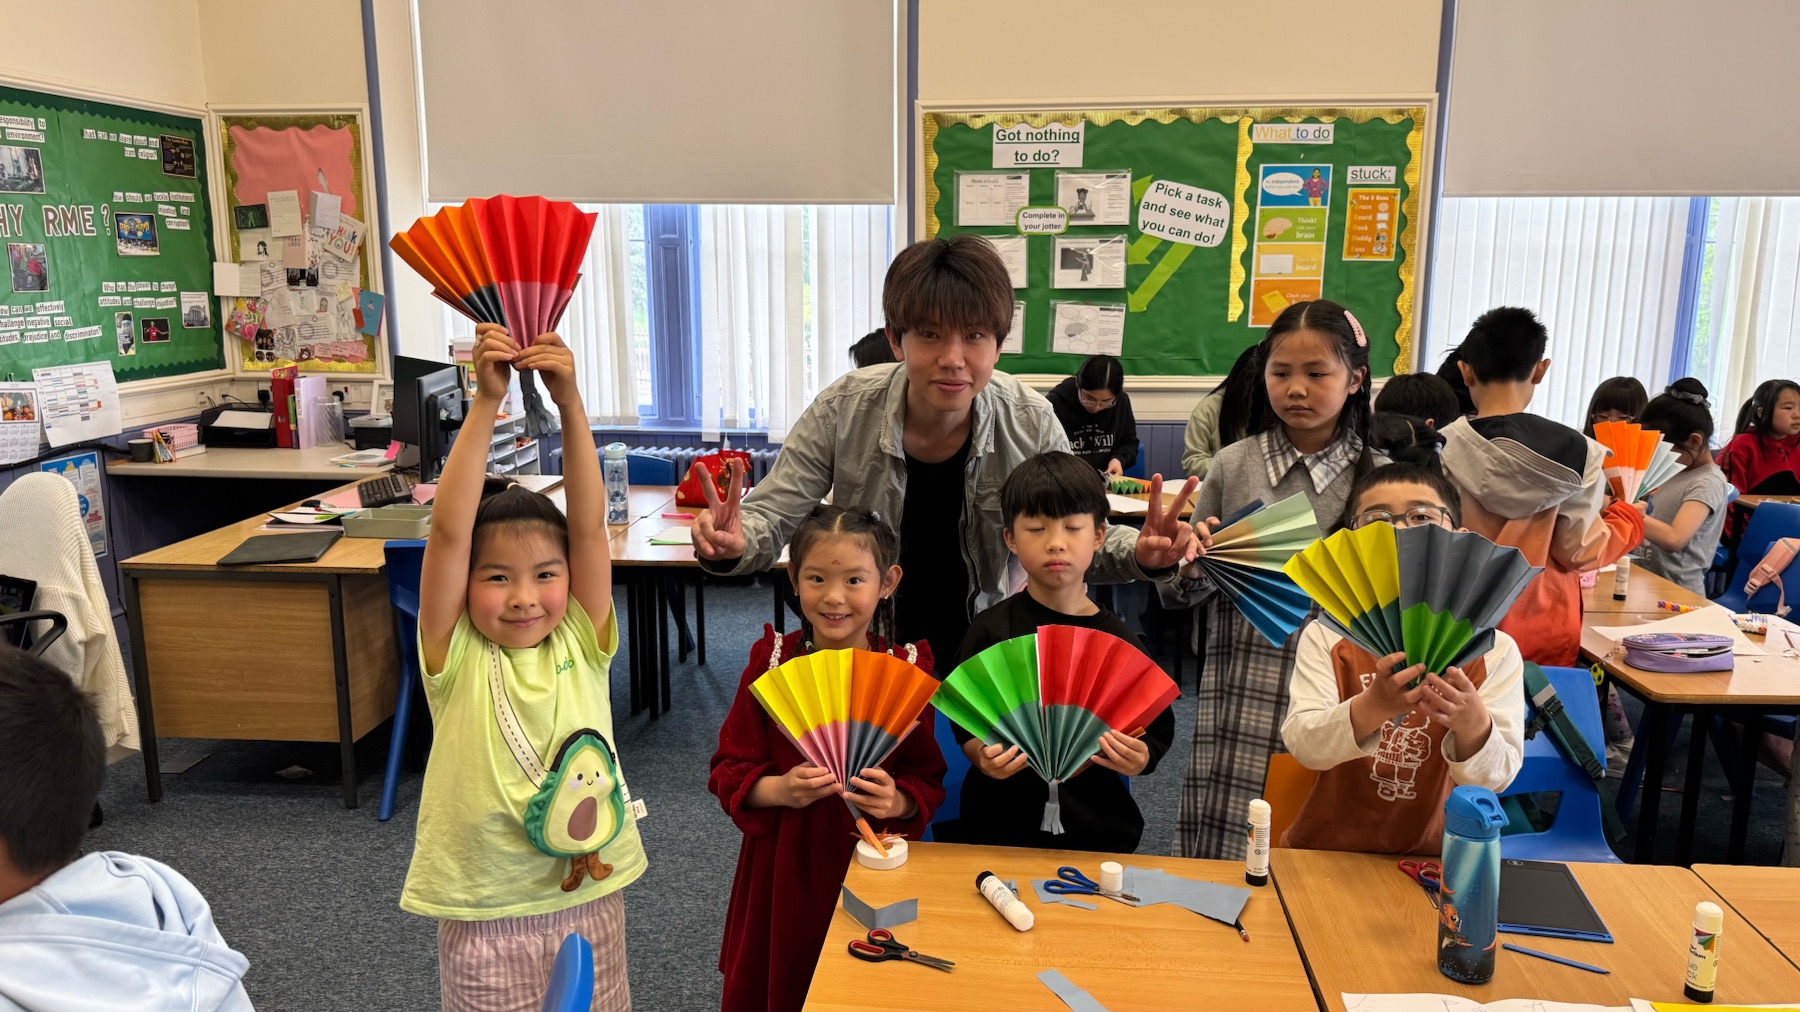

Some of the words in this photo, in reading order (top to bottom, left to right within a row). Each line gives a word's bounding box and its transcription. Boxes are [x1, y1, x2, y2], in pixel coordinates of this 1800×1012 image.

[39, 120, 45, 128] to
[7, 131, 44, 142] environment?
[996, 129, 1021, 141] Got
[1026, 129, 1080, 143] nothing
[1255, 126, 1292, 139] What
[1296, 128, 1309, 139] to
[1313, 126, 1330, 139] do
[1015, 150, 1028, 162] to
[1033, 149, 1060, 162] do?
[1350, 167, 1392, 180] stuck:
[1155, 182, 1182, 199] Pick
[1185, 192, 1194, 202] a
[1196, 193, 1224, 209] task
[42, 204, 97, 237] RME
[1022, 211, 1057, 222] Complete
[1142, 201, 1167, 214] and
[1169, 208, 1192, 220] see
[1195, 214, 1225, 229] what
[1041, 222, 1063, 231] jotter.
[1141, 219, 1166, 233] you
[1168, 226, 1191, 239] can
[1194, 230, 1216, 245] do!
[1295, 231, 1315, 239] brain
[1295, 262, 1317, 271] board
[103, 284, 114, 292] Who
[161, 282, 176, 291] change
[36, 302, 64, 313] effectively
[134, 298, 155, 308] challenge
[26, 318, 50, 329] negative
[54, 318, 72, 326] social
[23, 332, 47, 343] prejudice
[65, 326, 102, 341] discrimination?
